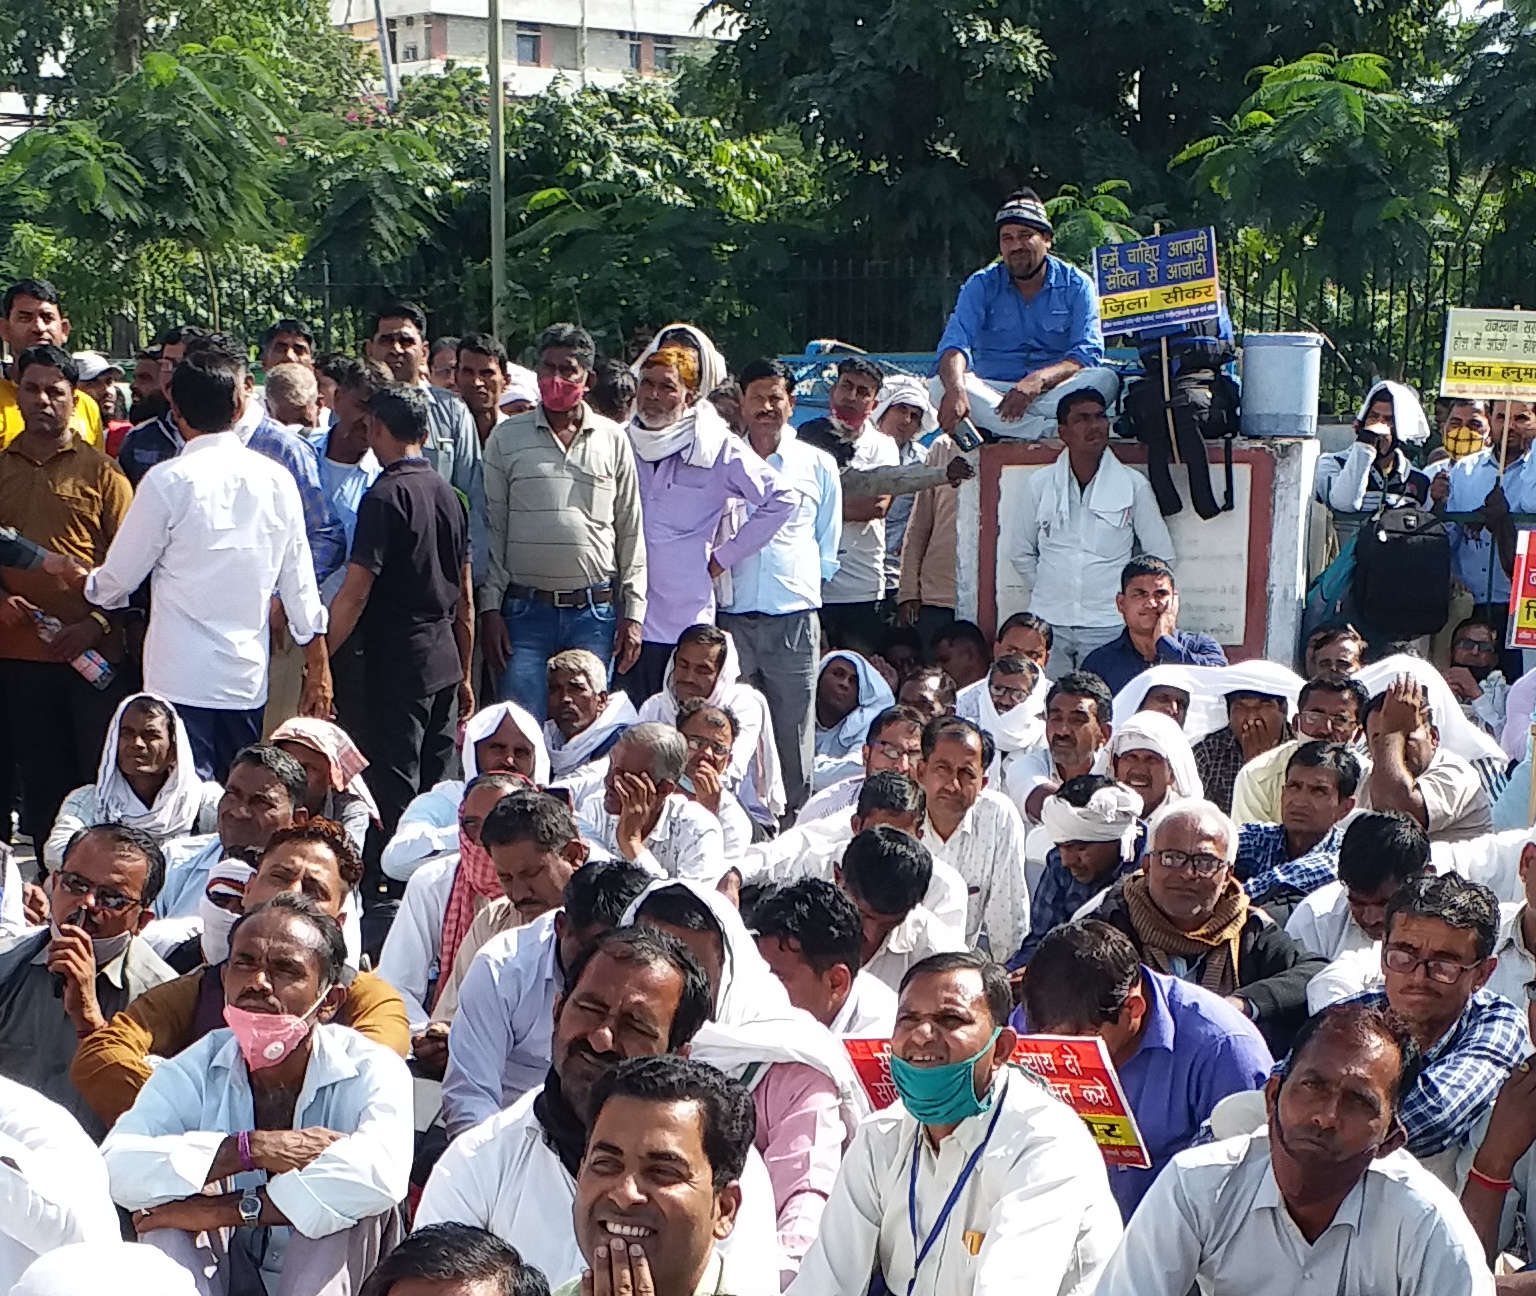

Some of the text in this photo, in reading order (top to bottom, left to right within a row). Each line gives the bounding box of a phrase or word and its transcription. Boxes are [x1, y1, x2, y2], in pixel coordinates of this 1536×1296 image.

[1100, 246, 1119, 271] हमें
[1127, 241, 1160, 263] चाहिए
[1105, 267, 1139, 290] संविदा
[1147, 261, 1159, 283] से
[1161, 285, 1214, 304] सीकर
[1485, 318, 1519, 333] राजस्थान
[1453, 331, 1469, 351] होश
[1474, 332, 1482, 350] में
[1061, 1044, 1083, 1076] दो
[1079, 1076, 1113, 1107] करो
